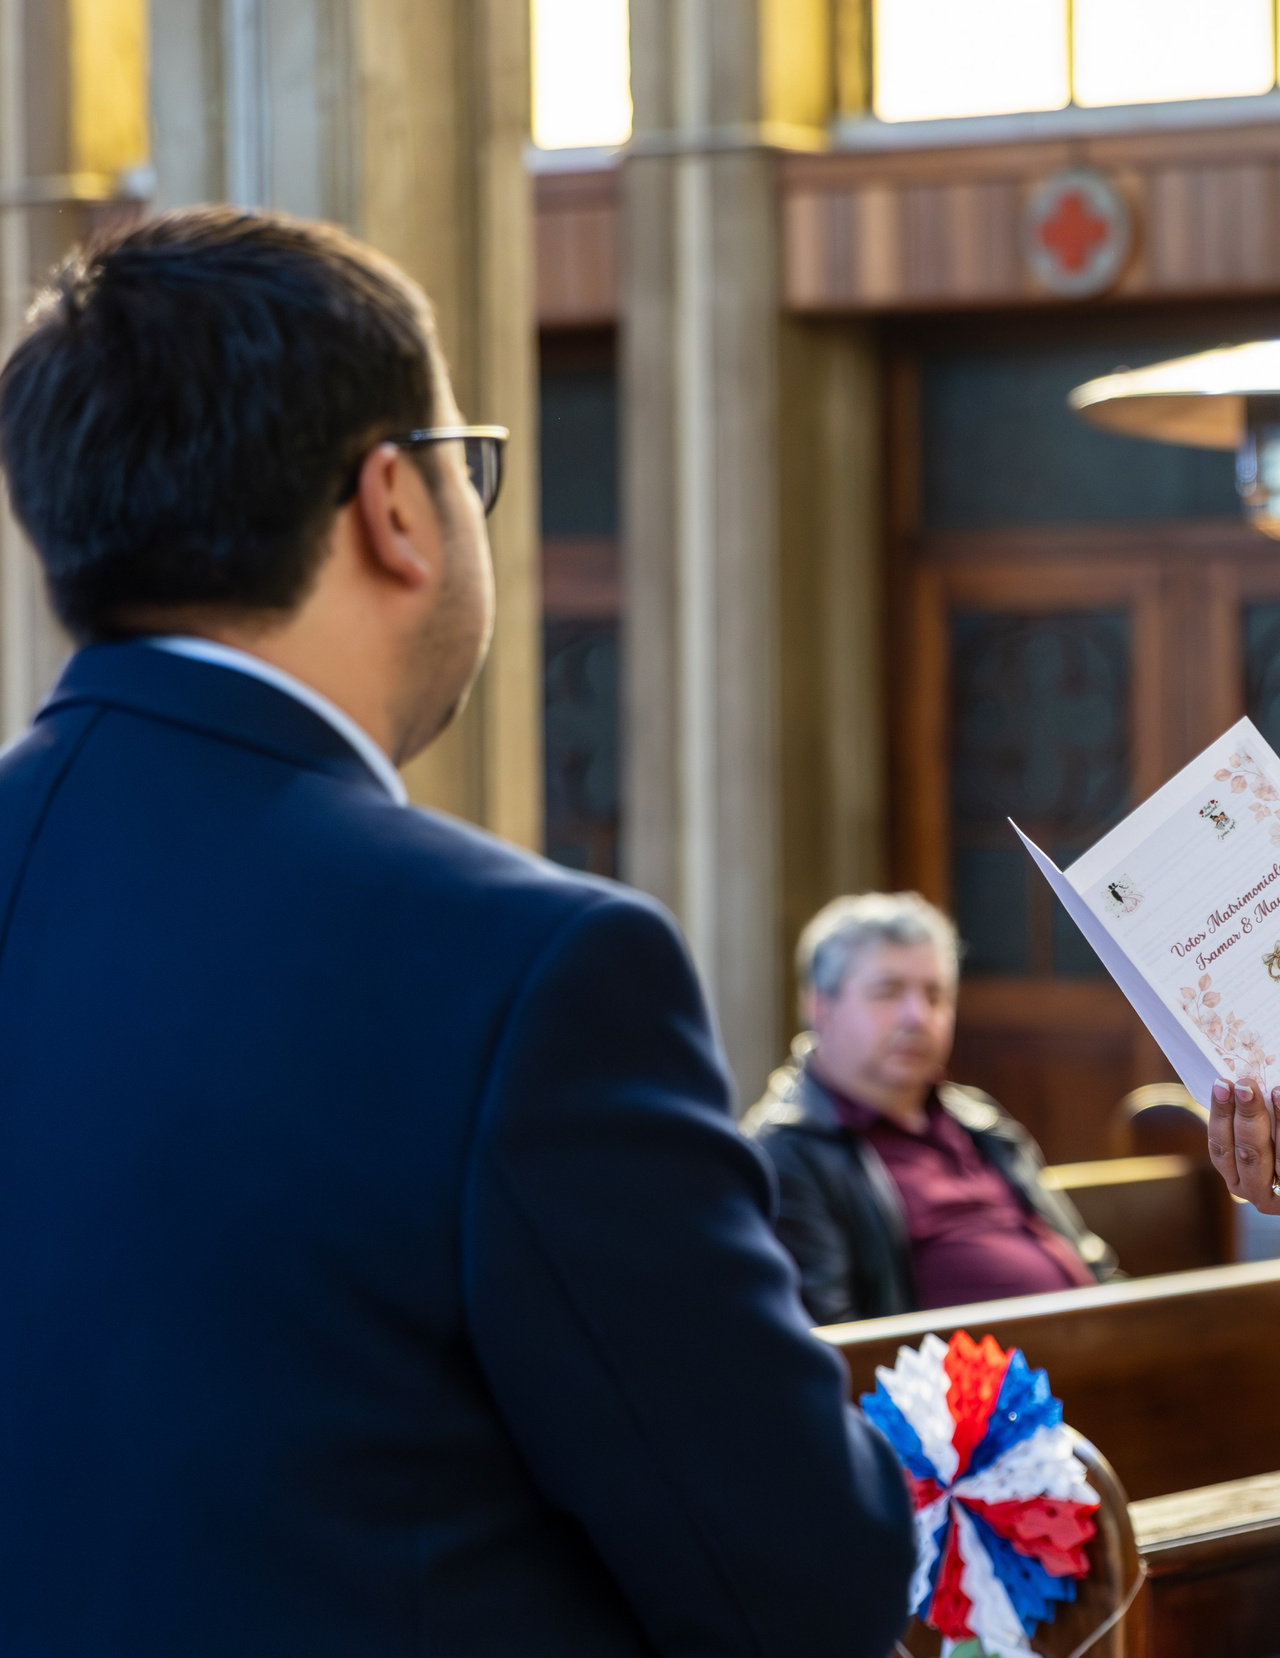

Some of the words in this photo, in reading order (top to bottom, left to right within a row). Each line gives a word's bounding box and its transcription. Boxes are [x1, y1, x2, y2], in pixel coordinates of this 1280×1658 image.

[1171, 932, 1206, 957] Votos
[1196, 932, 1241, 971] Isamar
[1241, 917, 1253, 934] &
